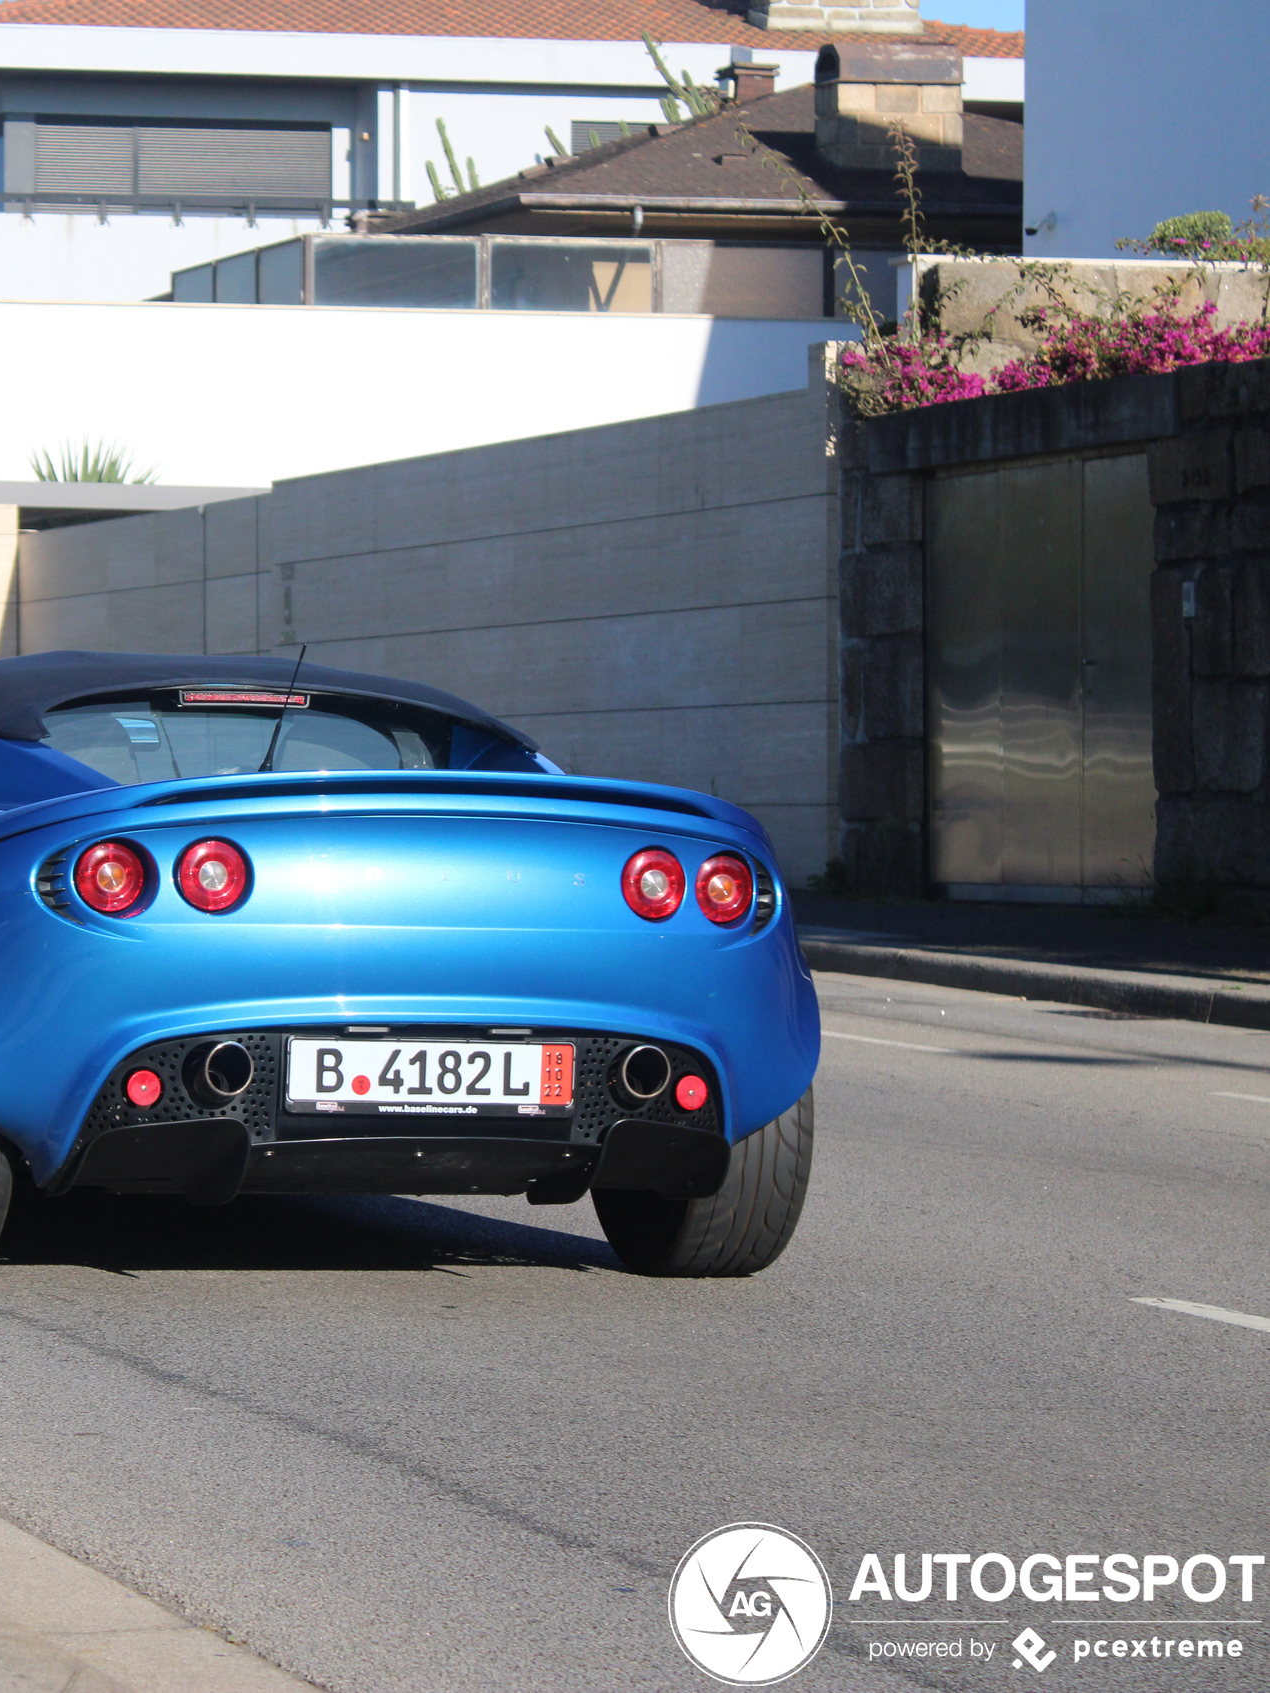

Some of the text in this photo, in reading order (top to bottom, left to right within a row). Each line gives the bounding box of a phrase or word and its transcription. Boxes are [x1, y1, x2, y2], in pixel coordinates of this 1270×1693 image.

[545, 1052, 562, 1065] 18
[316, 1048, 344, 1093] B
[545, 1068, 562, 1081] 10
[544, 1084, 562, 1097] 22
[378, 1105, 478, 1114] www.baselinecars.de
